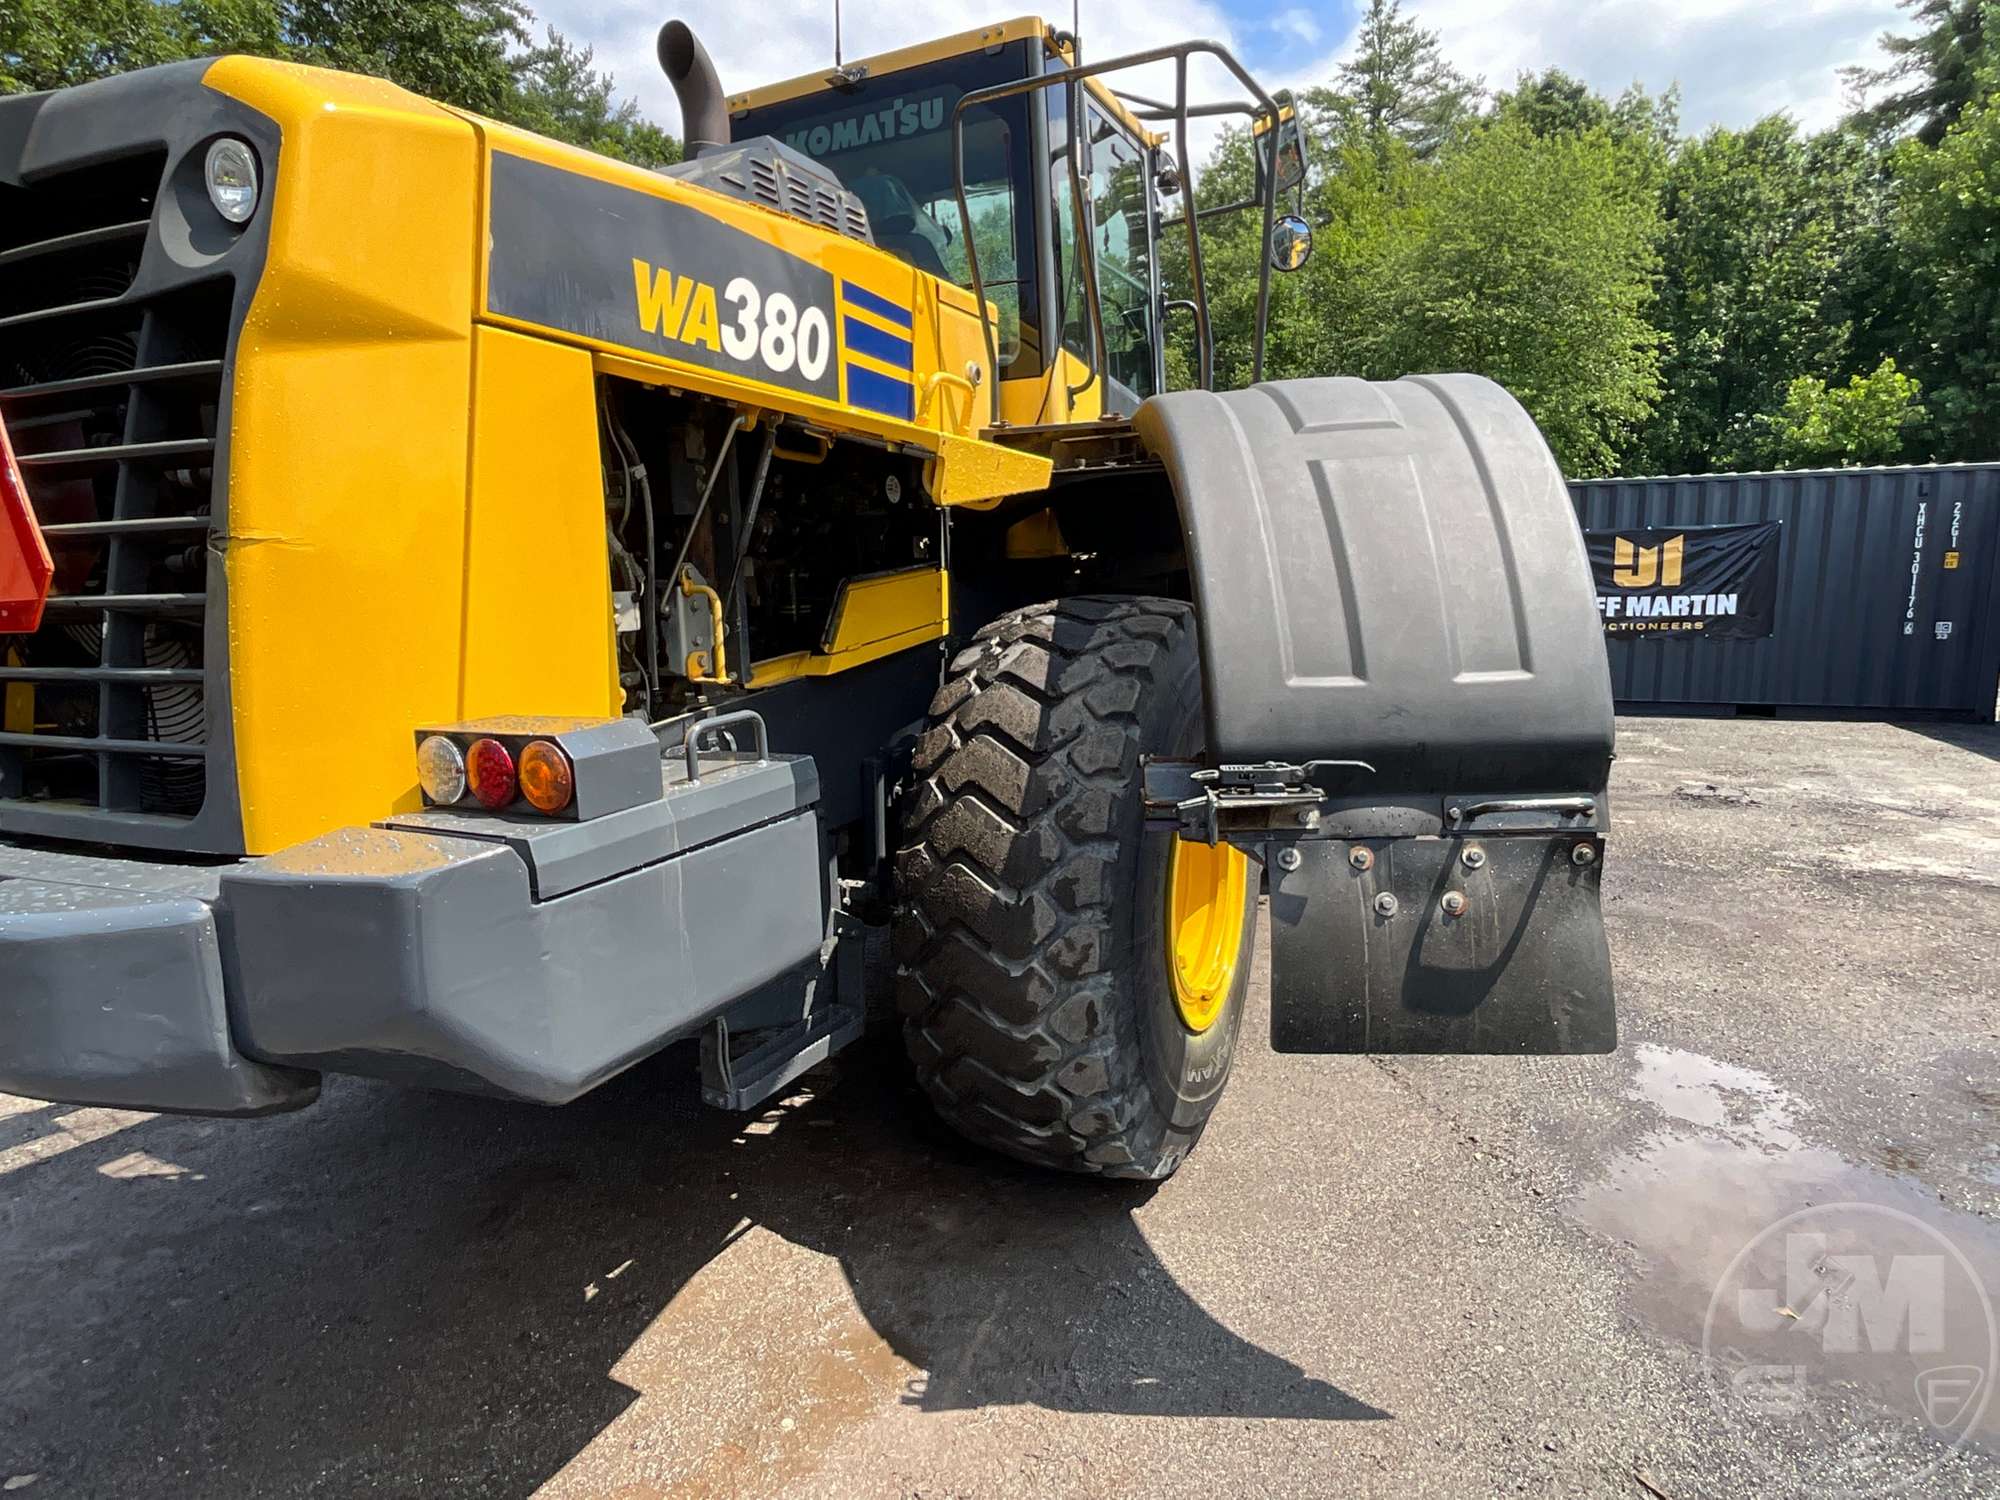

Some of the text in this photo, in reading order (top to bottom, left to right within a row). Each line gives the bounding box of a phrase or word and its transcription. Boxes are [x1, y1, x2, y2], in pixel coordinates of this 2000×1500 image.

[785, 98, 944, 156] KOMATSU
[632, 257, 830, 382] WA380
[1914, 502, 1927, 549] XHCU
[1625, 593, 1737, 617] MARTIN
